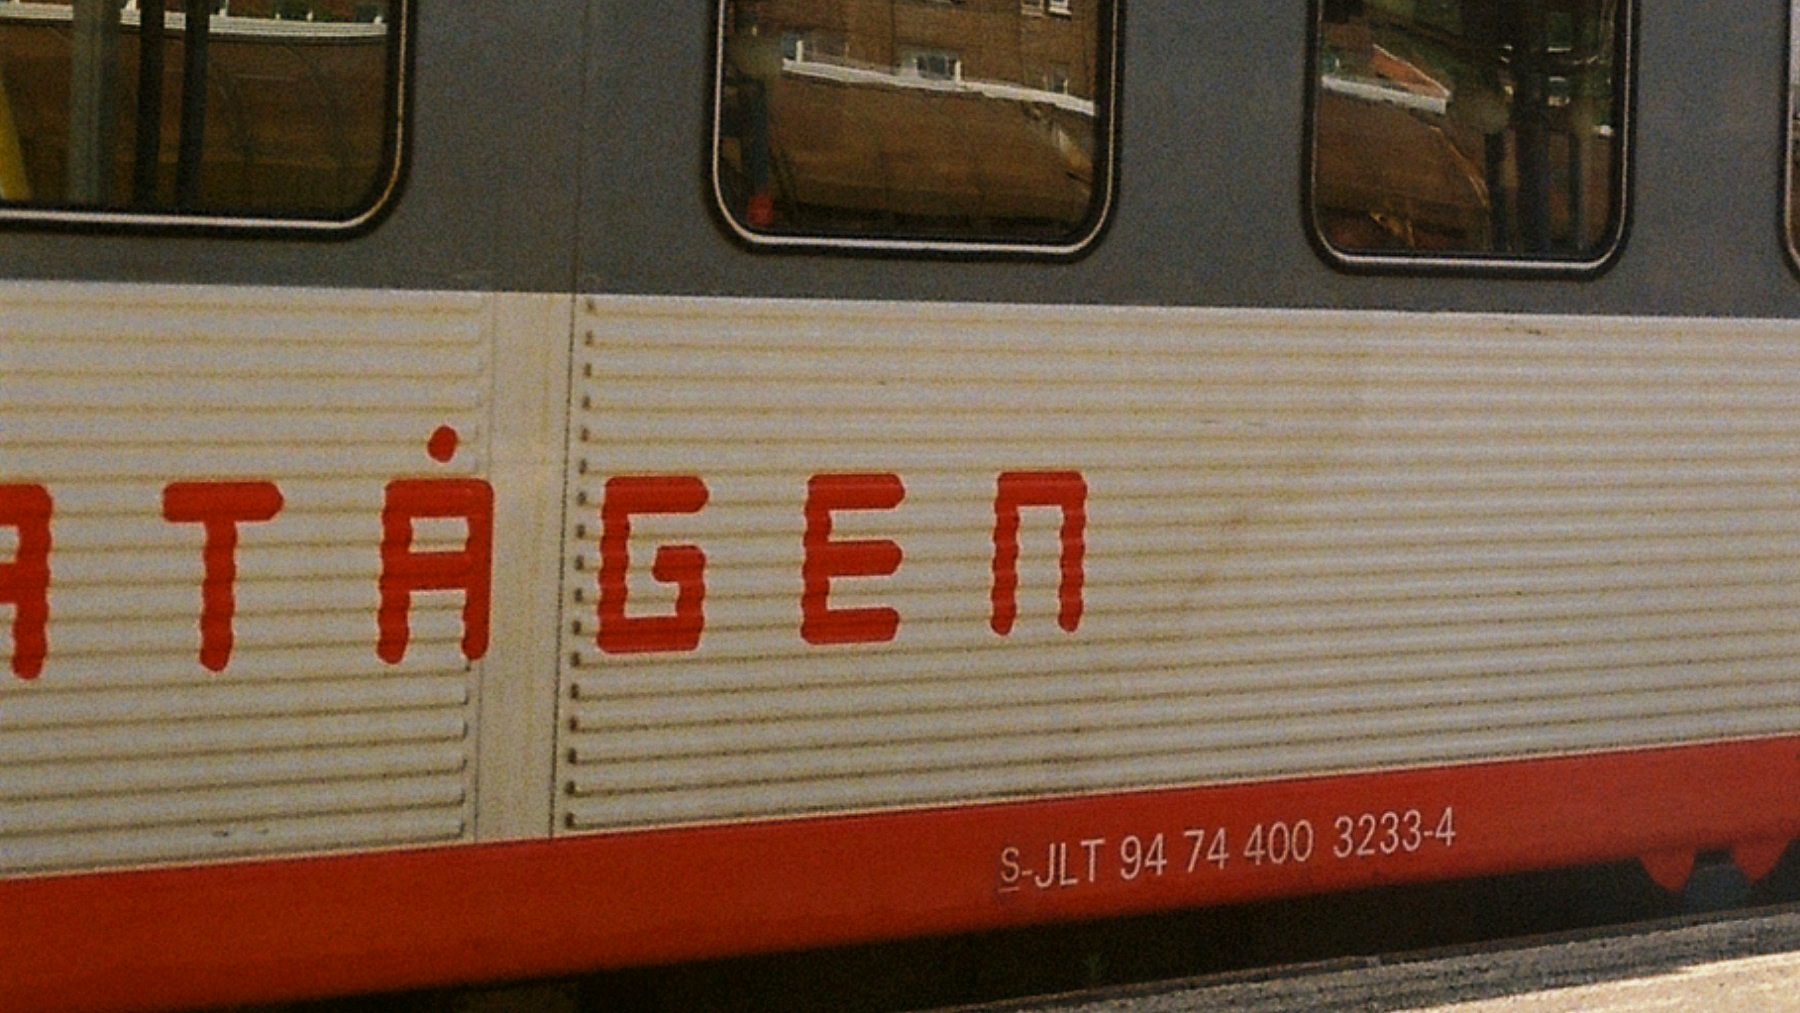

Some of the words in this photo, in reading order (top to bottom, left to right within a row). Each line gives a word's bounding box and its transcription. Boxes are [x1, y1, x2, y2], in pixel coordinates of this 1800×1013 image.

[1000, 838, 1105, 892] S-JLT
[1120, 833, 1167, 880] 94
[1184, 826, 1229, 873] 74
[1244, 819, 1314, 866] 400
[1332, 806, 1457, 859] 3233-4
